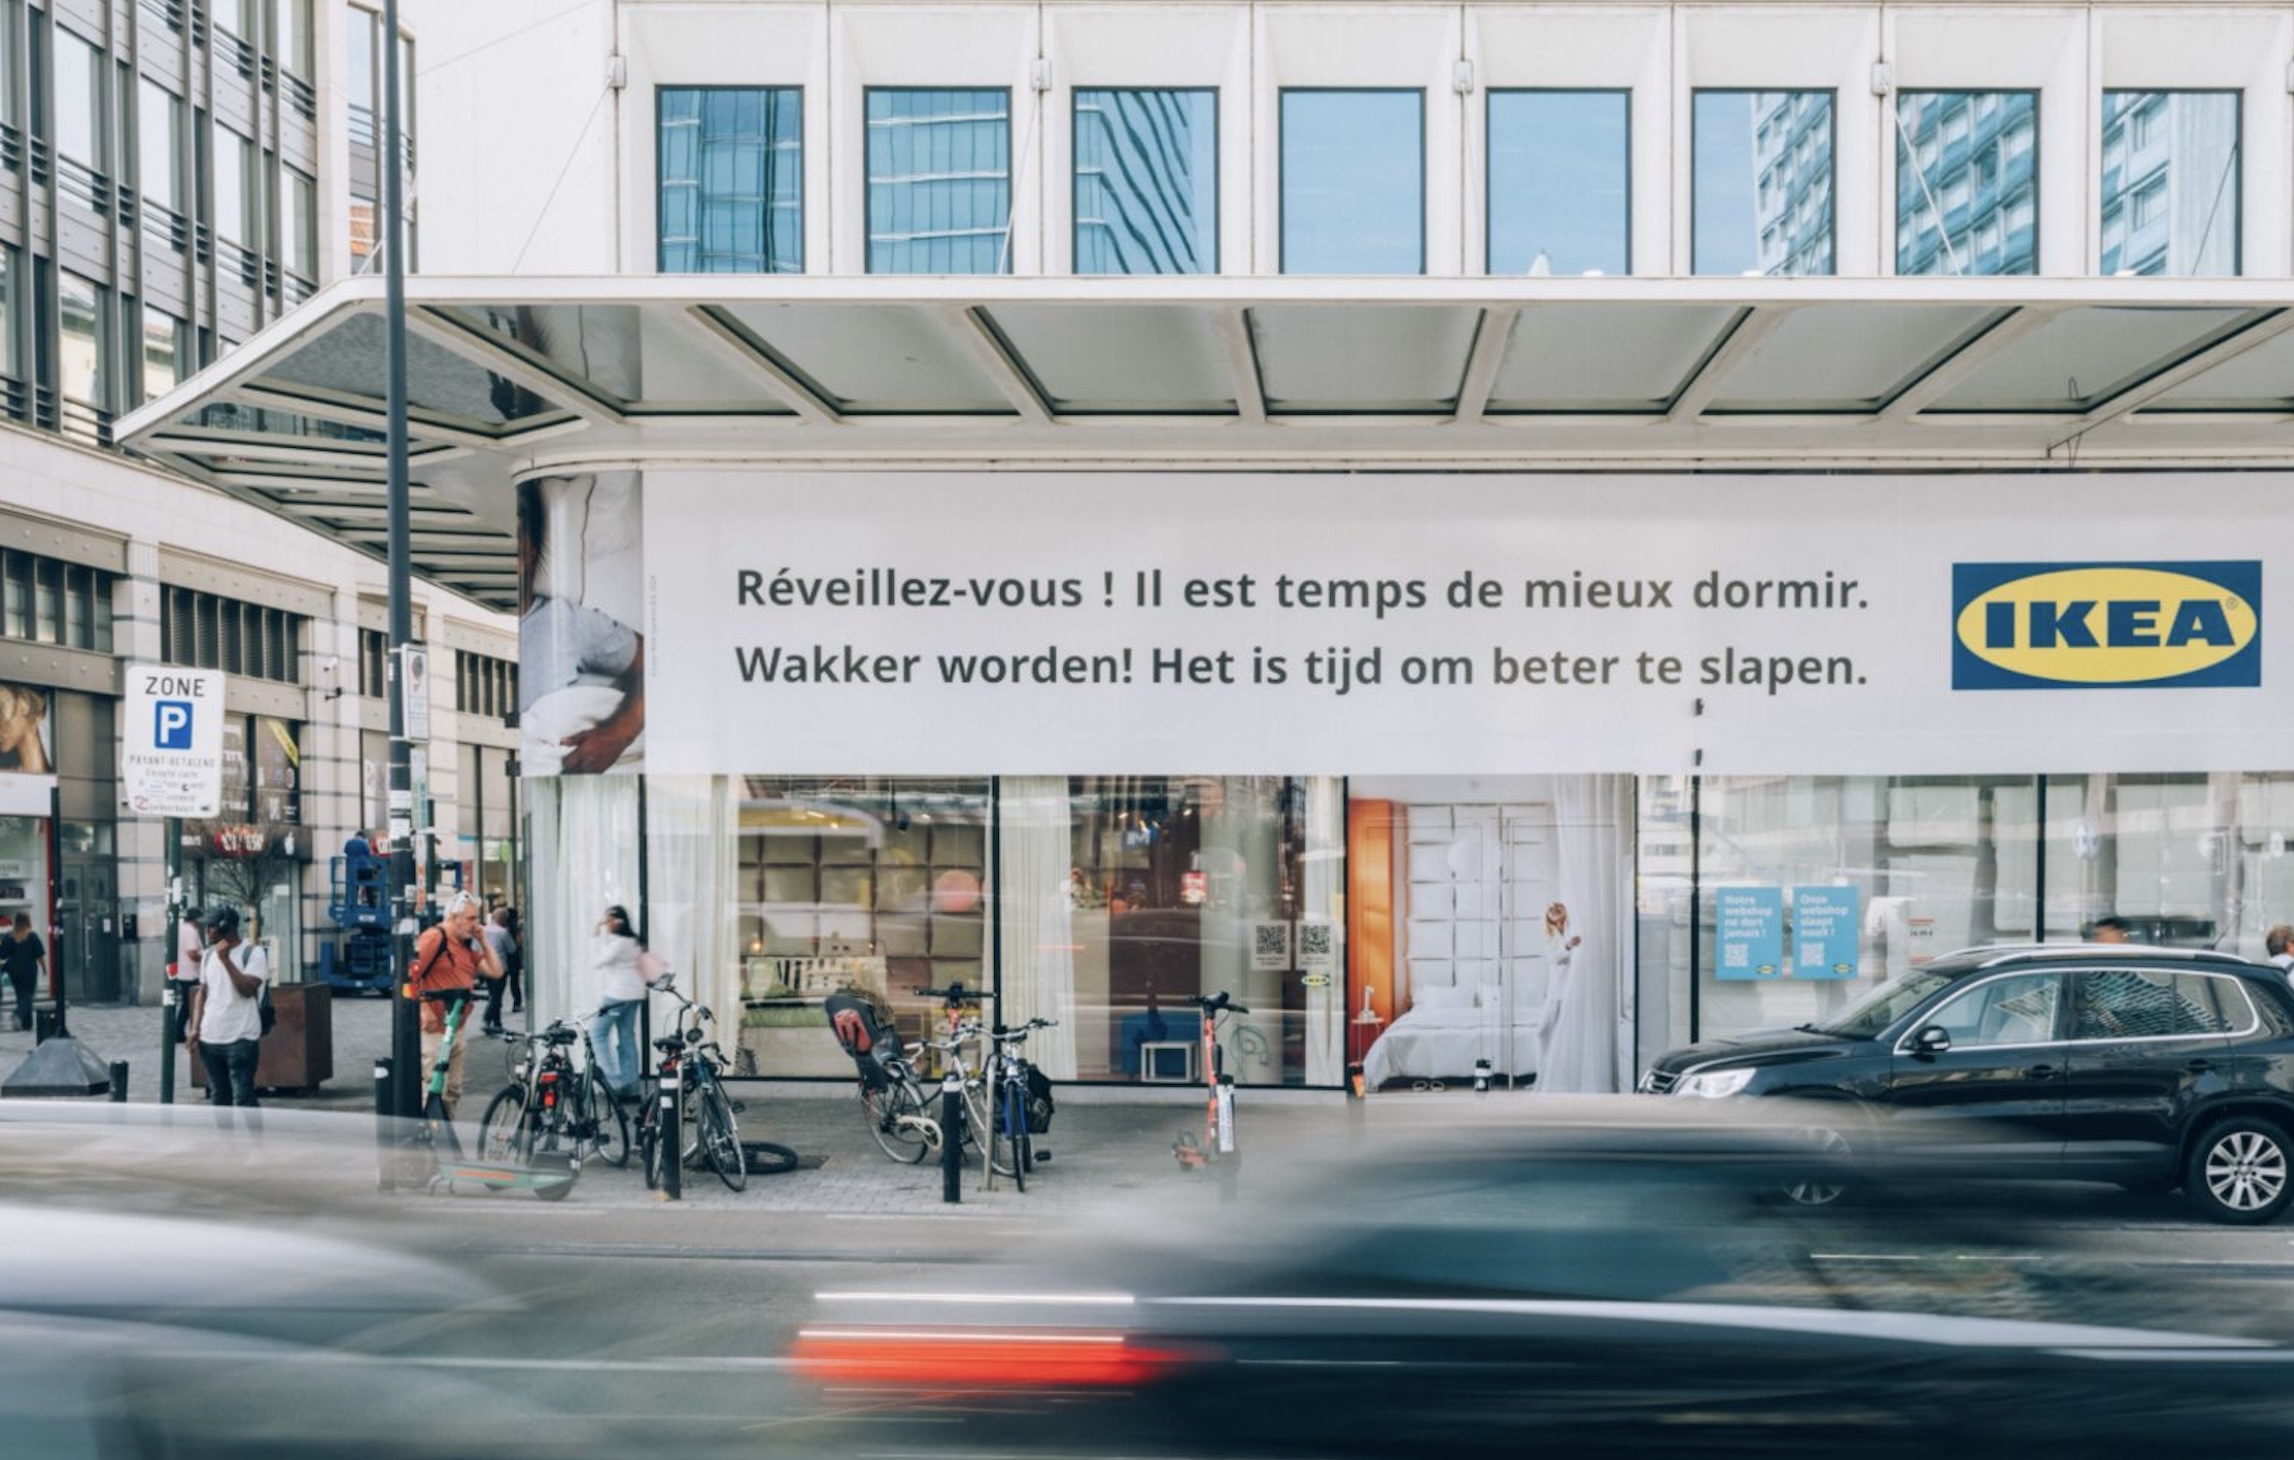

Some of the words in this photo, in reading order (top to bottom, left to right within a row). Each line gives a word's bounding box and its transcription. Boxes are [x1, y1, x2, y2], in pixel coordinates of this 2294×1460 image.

[737, 567, 1083, 608] Réveillez-vous
[1103, 571, 1114, 608] !
[1136, 569, 1162, 608] Il
[1183, 573, 1257, 608] est
[1275, 573, 1427, 620] temps
[1446, 570, 1504, 609] de
[1525, 570, 1673, 609] mieux
[1693, 571, 1868, 609] dormir.
[1986, 600, 2236, 648] IKEA
[145, 676, 205, 697] ZONE
[735, 645, 921, 684] Wakker
[936, 646, 1133, 684] worden!
[1152, 647, 1235, 685] Het
[1253, 646, 1288, 685] is
[1304, 647, 1382, 696] tijd
[1400, 656, 1473, 685] om
[1493, 647, 1620, 685] beter
[1635, 651, 1683, 685] te
[1700, 647, 1867, 696] slapen.
[160, 705, 187, 744] P
